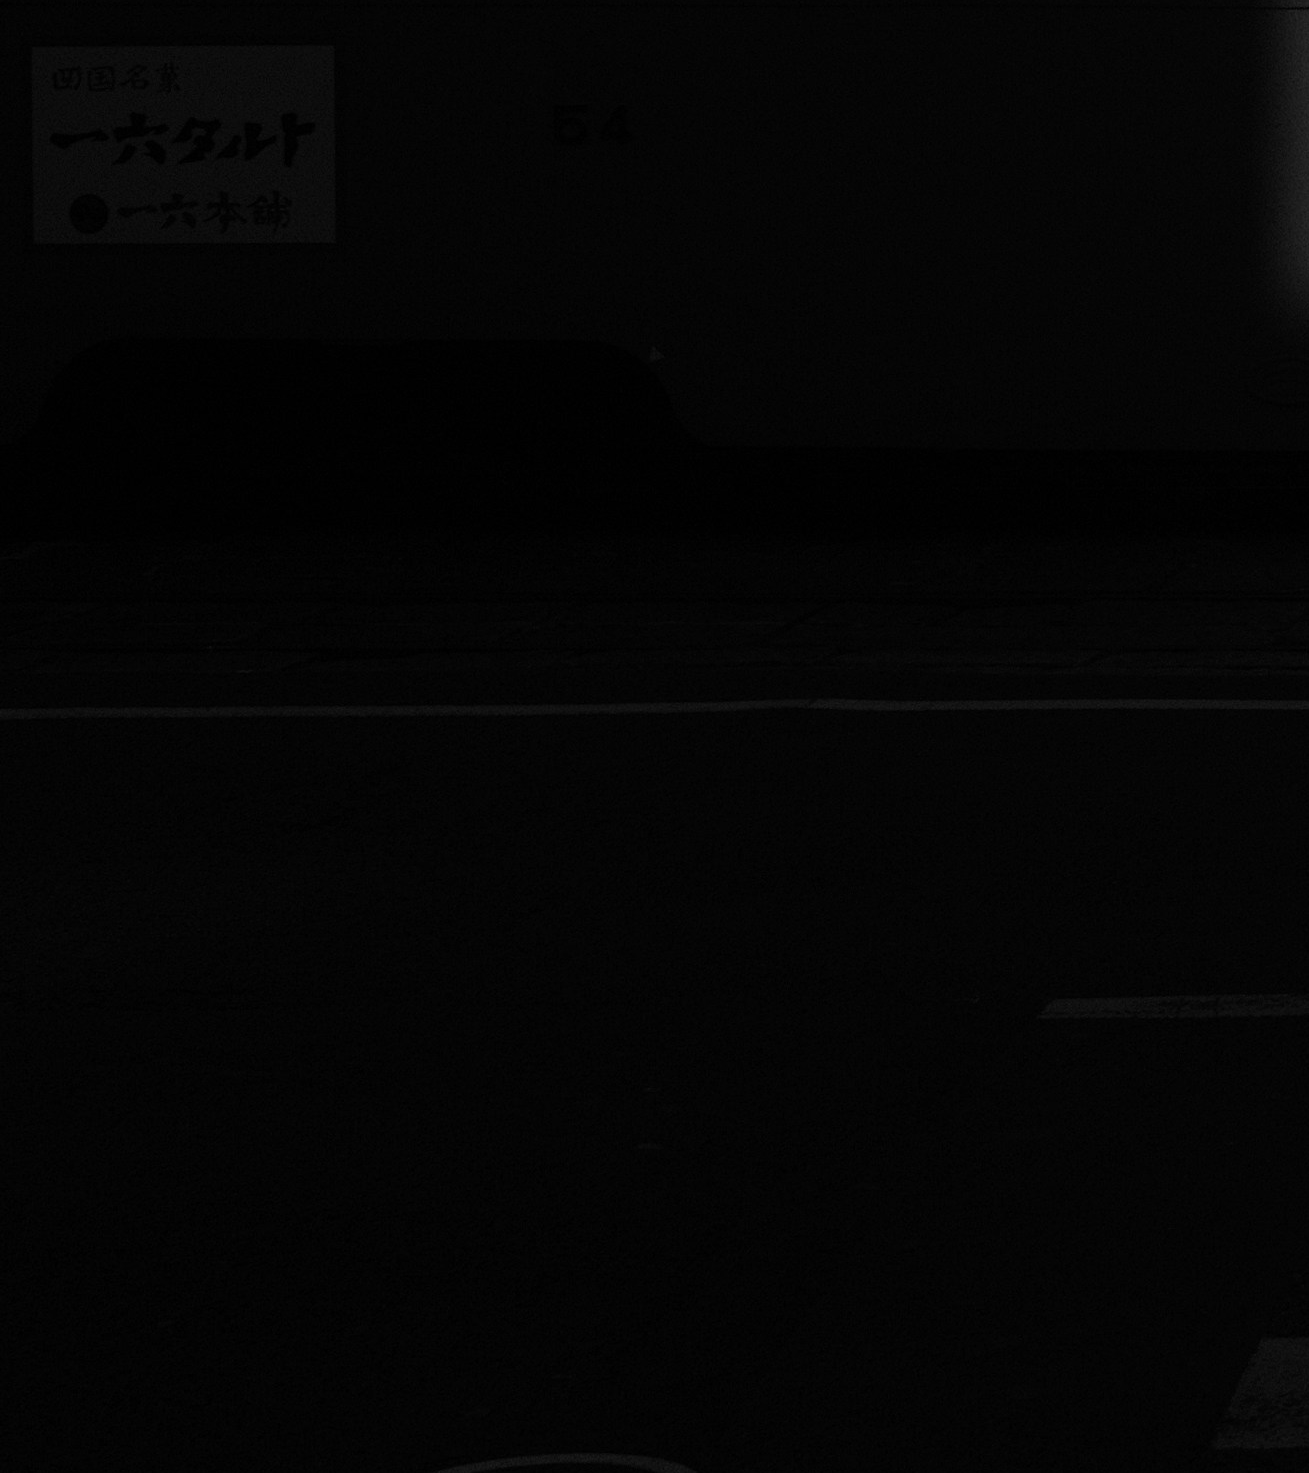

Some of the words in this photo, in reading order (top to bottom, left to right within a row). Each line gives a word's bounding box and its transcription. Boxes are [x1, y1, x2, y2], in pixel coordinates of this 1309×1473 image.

[51, 61, 182, 95] 四国名菓
[49, 112, 317, 168] 一六タルト
[552, 104, 637, 146] 54
[117, 190, 293, 234] 一六本舗
